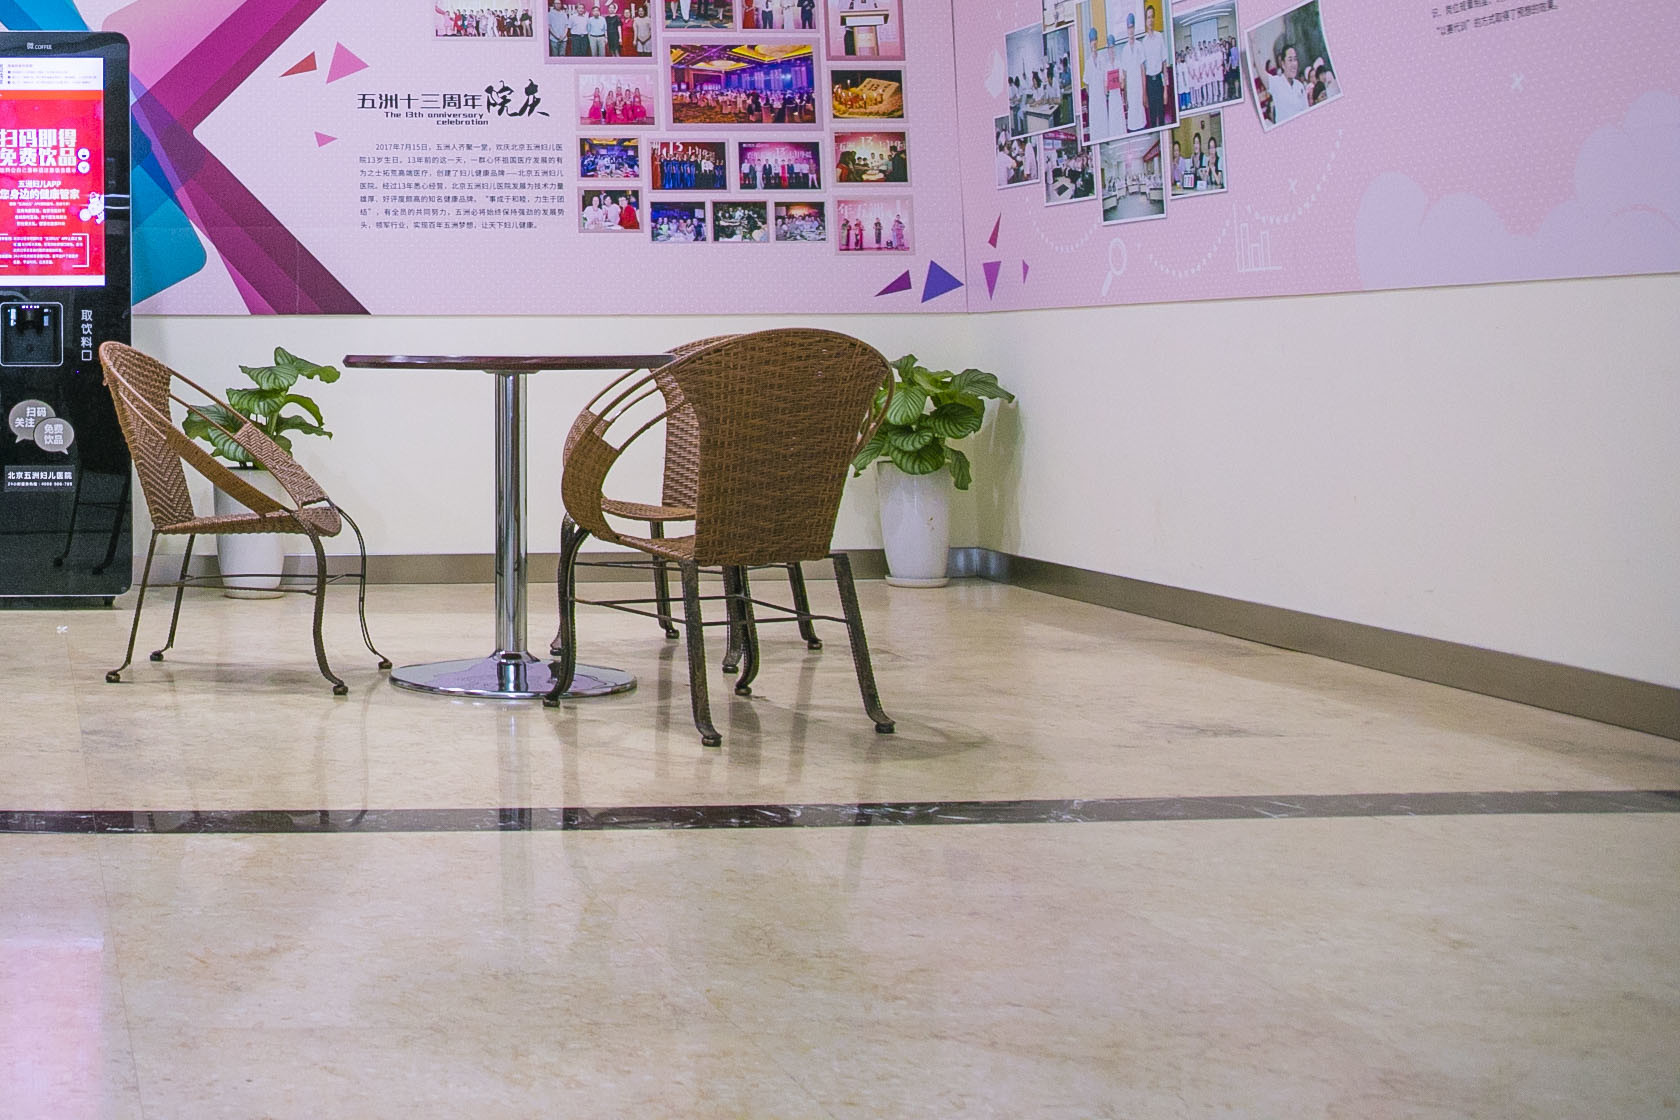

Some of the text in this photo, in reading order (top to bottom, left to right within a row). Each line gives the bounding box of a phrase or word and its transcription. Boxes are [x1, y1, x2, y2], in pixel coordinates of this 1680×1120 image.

[427, 111, 484, 119] anniversary
[80, 309, 94, 361] 取饮料口
[25, 406, 47, 417] 扫码
[14, 417, 35, 428] 关注
[43, 423, 64, 434] 免费
[43, 434, 64, 445] 饮品
[7, 471, 73, 480] 北京五洲妇儿医院
